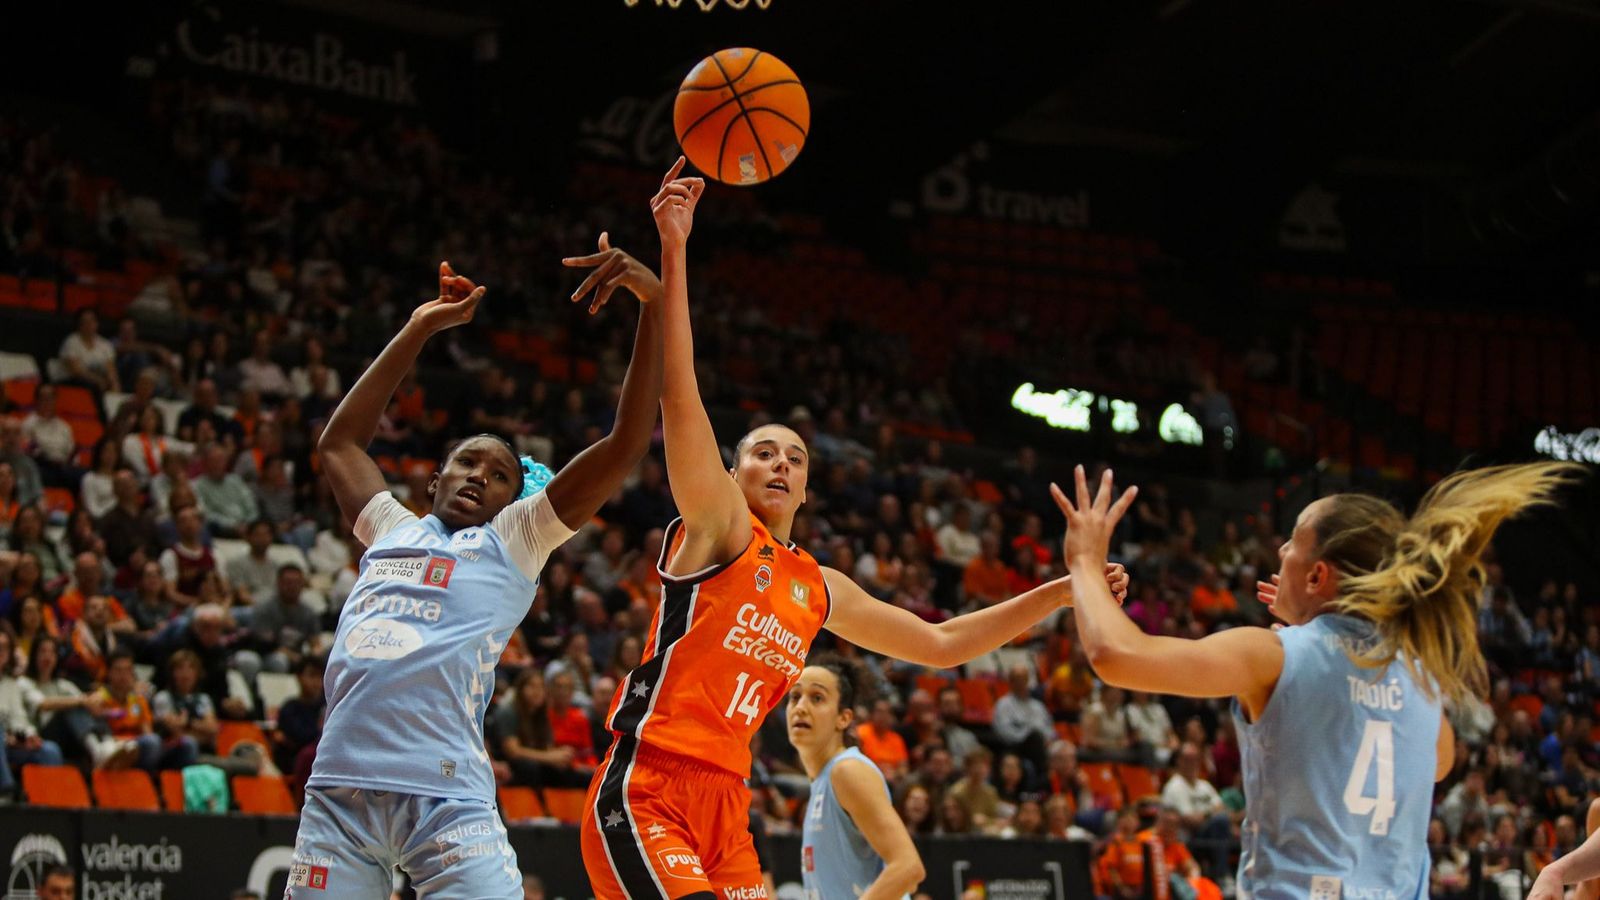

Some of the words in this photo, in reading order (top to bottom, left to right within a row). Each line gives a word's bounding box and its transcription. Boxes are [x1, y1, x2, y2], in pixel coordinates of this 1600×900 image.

[176, 10, 420, 106] CaixaBank
[977, 183, 1090, 227] travel
[374, 561, 422, 570] CONCELLO
[376, 568, 389, 576] DE
[391, 569, 414, 578] VIGO
[736, 602, 802, 654] Cultura
[725, 671, 765, 726] 14
[1346, 674, 1403, 711] TADIĆ
[1343, 719, 1396, 837] 4
[82, 834, 182, 870] valencia
[82, 873, 163, 900] basket
